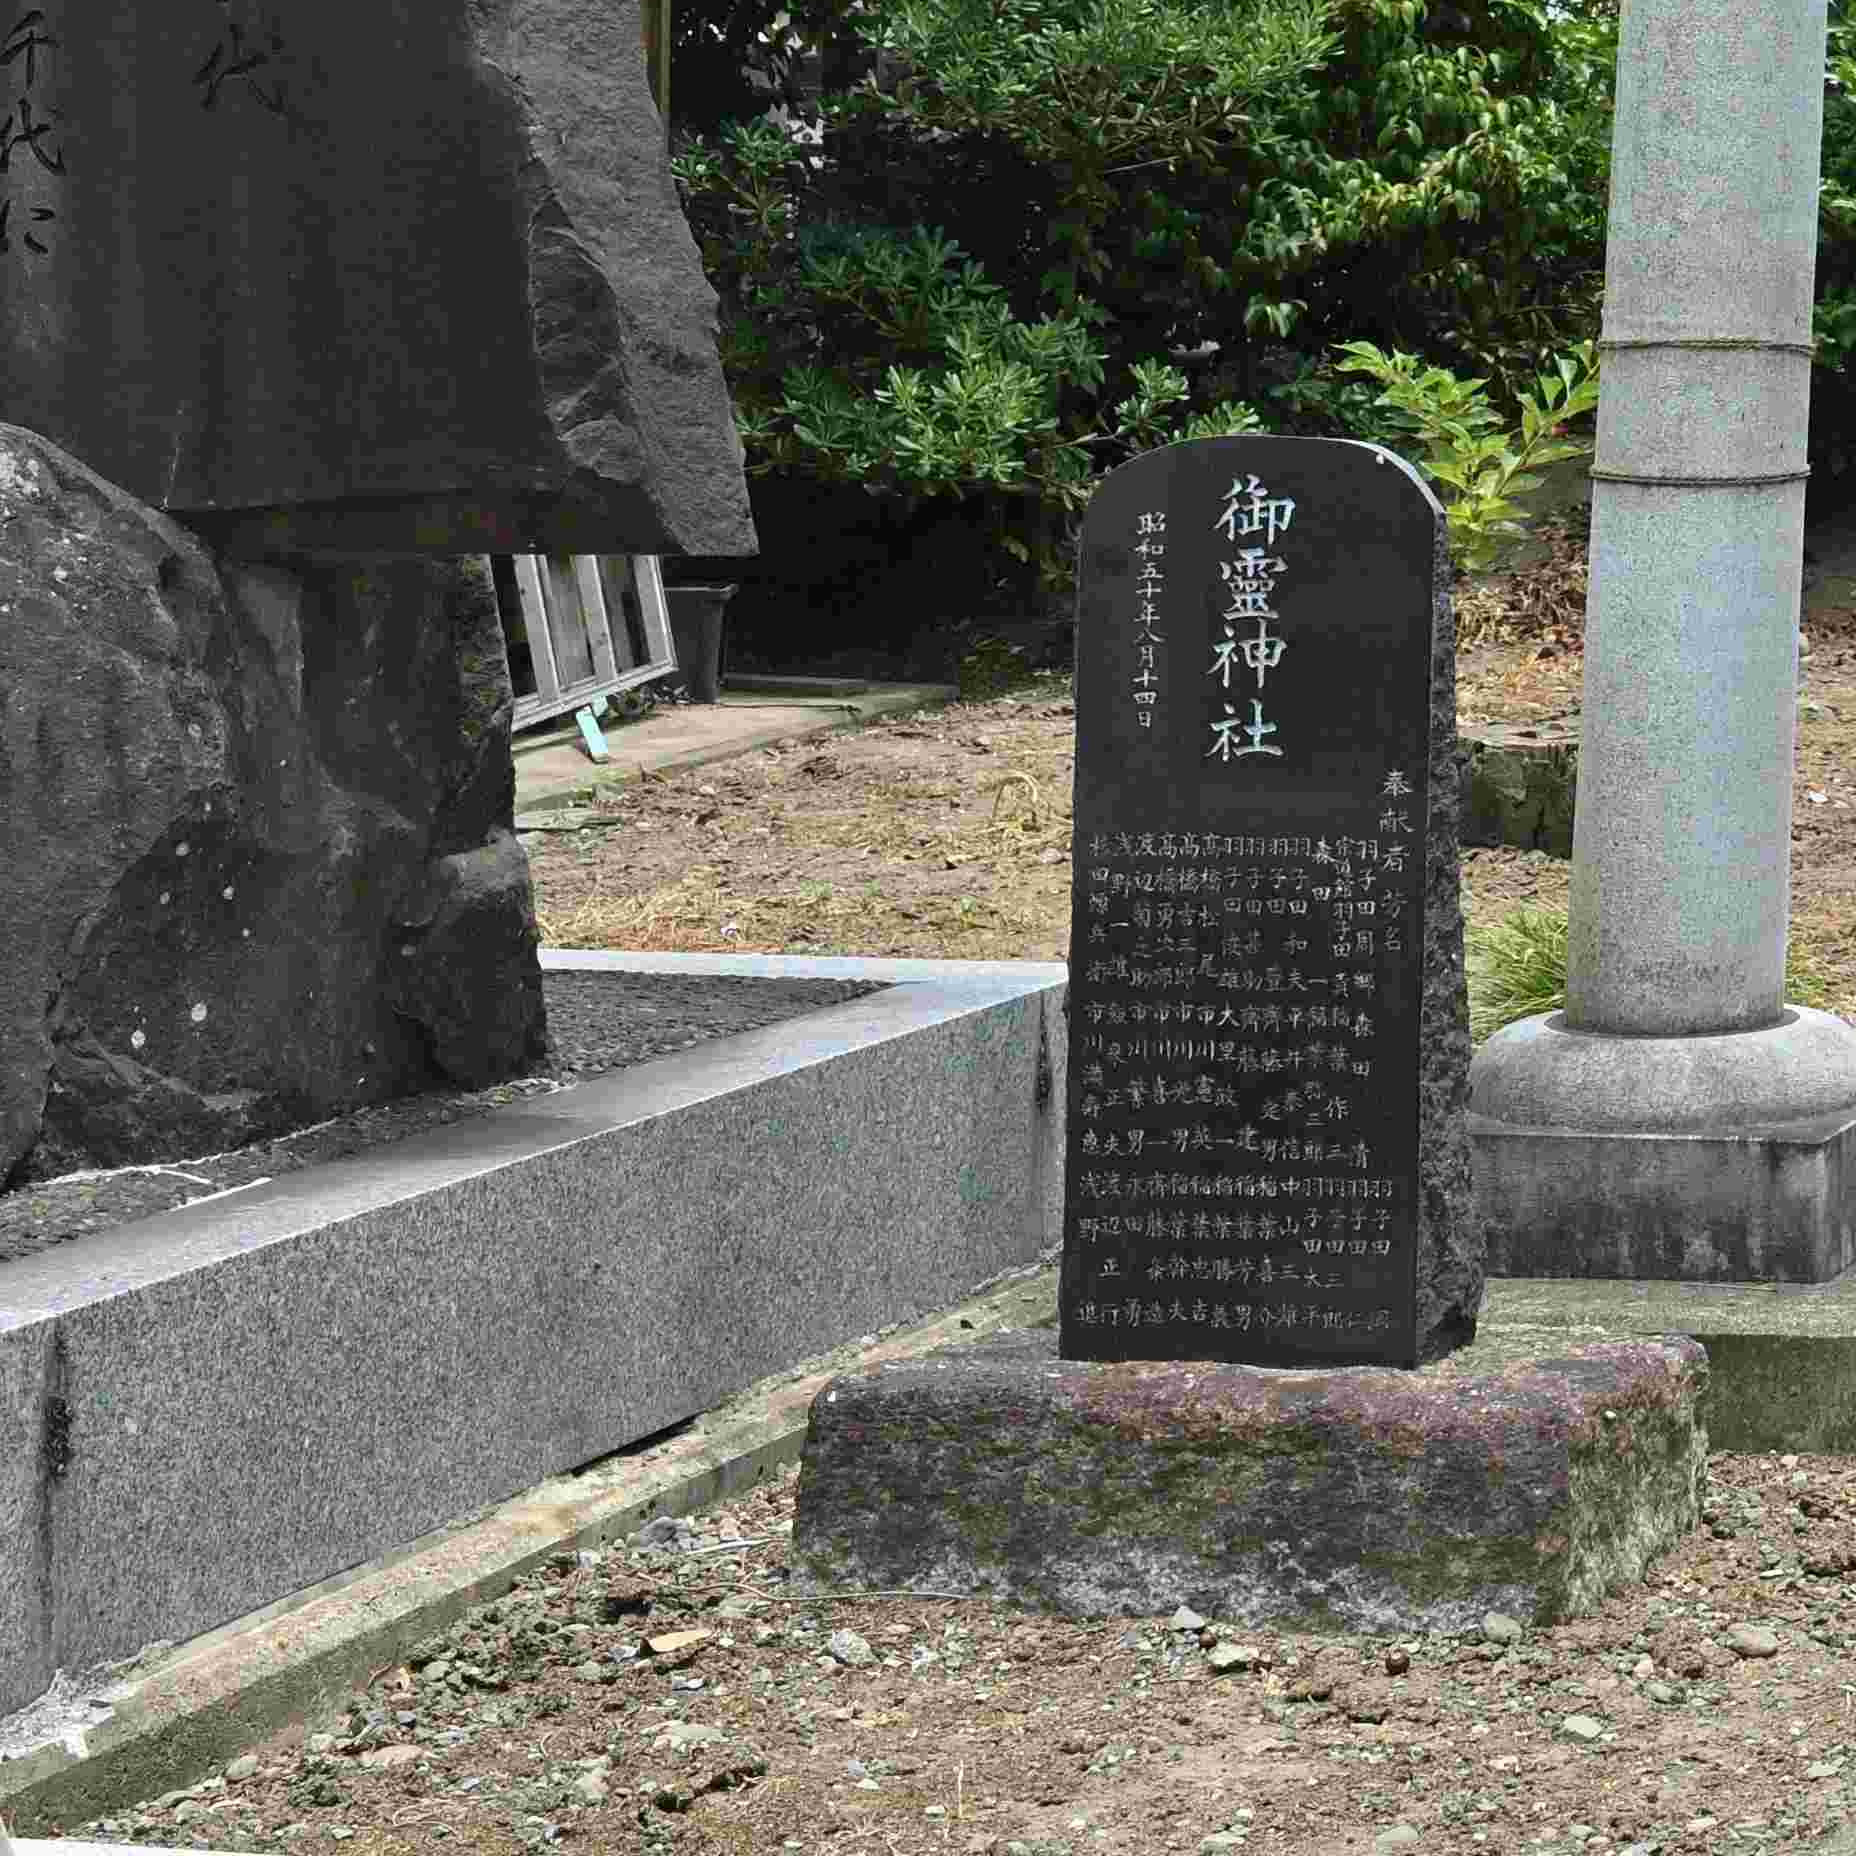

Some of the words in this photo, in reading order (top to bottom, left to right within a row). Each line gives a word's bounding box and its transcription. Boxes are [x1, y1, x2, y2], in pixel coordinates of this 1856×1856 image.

[1133, 510, 1166, 730] 昭和五十年八月十四日
